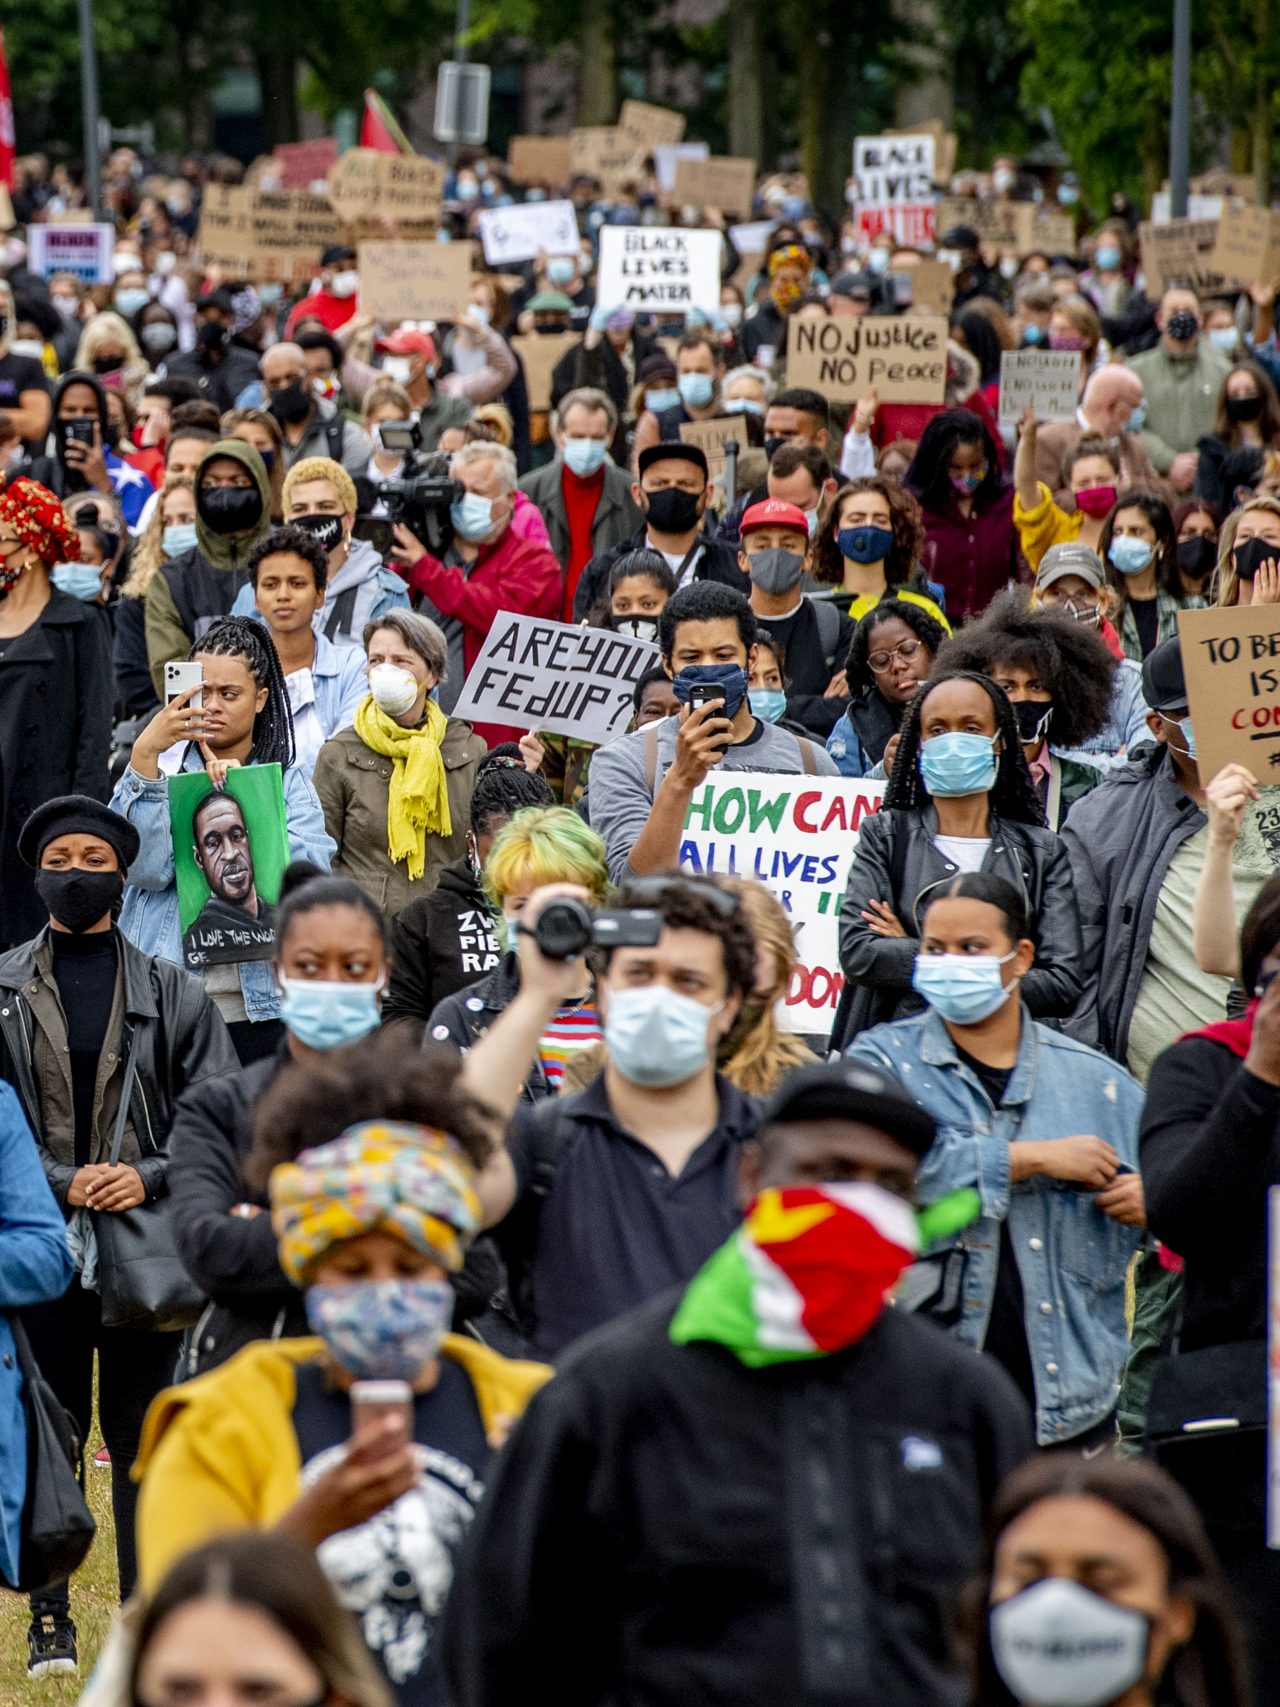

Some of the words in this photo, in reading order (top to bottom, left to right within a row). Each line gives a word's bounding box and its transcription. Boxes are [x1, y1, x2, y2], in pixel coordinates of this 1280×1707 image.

[625, 229, 688, 251] BLACK
[622, 257, 689, 276] LIVES
[798, 323, 841, 355] NO
[820, 358, 857, 386] NO
[869, 358, 943, 385] Peace
[1199, 637, 1240, 665] TO
[683, 785, 791, 834] HOW
[679, 840, 741, 876] ALL
[754, 847, 840, 884] LIVES
[199, 928, 225, 947] LOVE
[224, 929, 251, 946] THE
